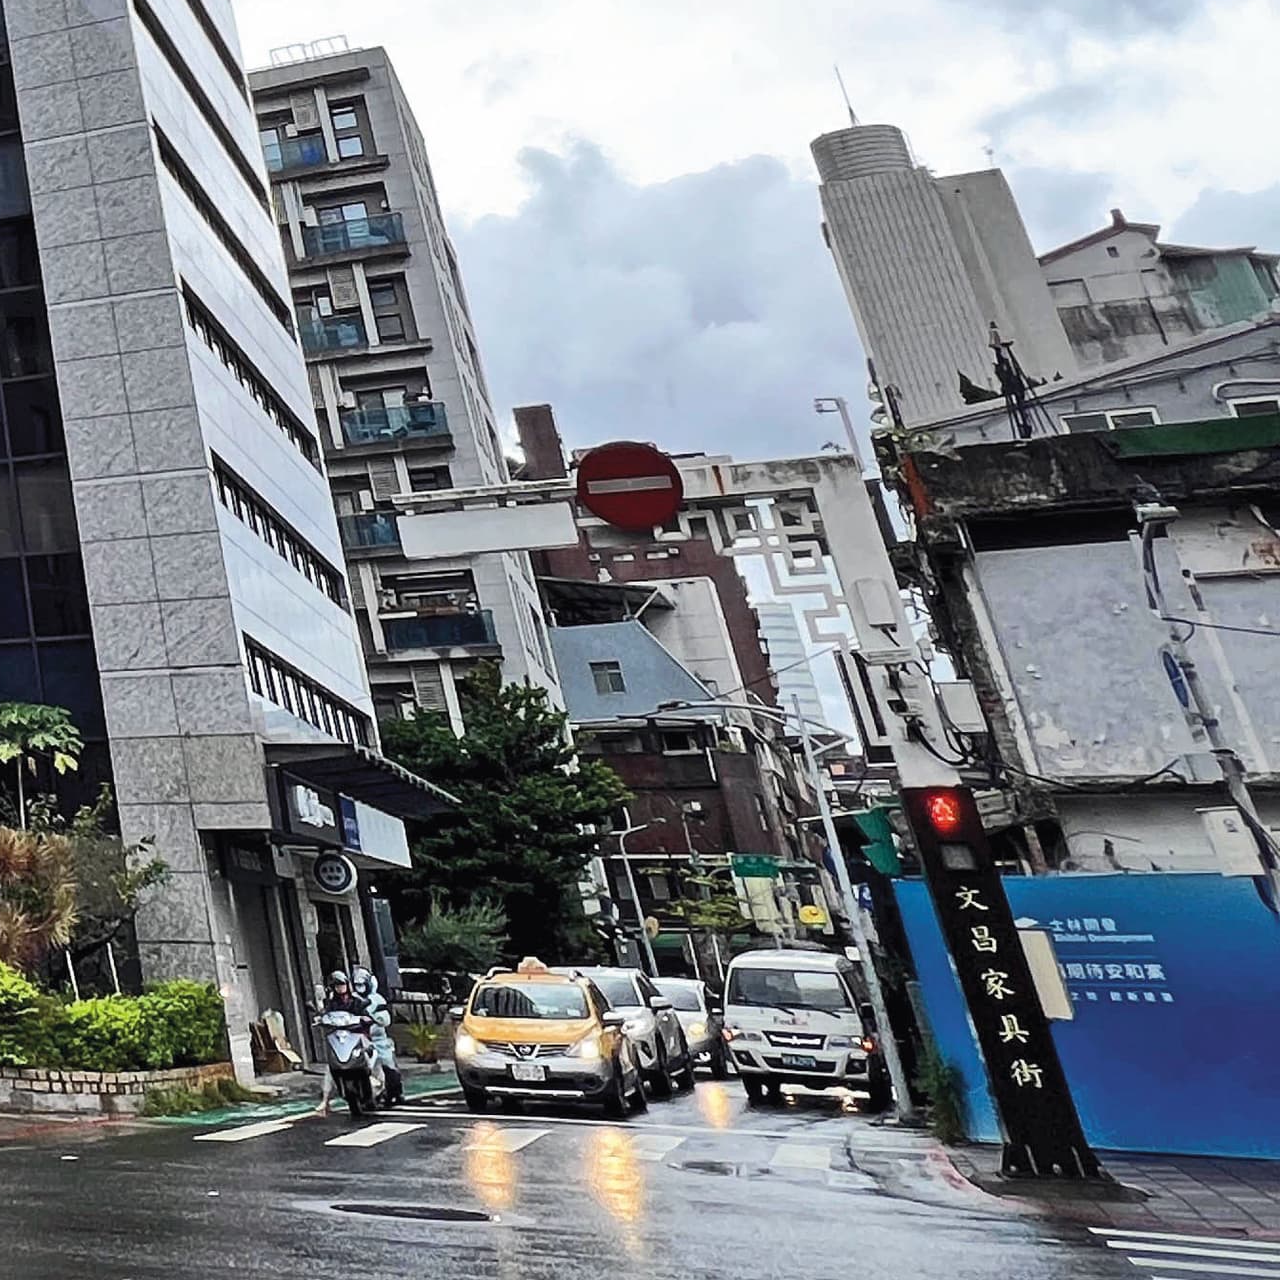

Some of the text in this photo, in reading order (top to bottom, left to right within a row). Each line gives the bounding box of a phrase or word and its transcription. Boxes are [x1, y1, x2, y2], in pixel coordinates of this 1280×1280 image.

[955, 886, 1043, 1089] 文昌家具街
